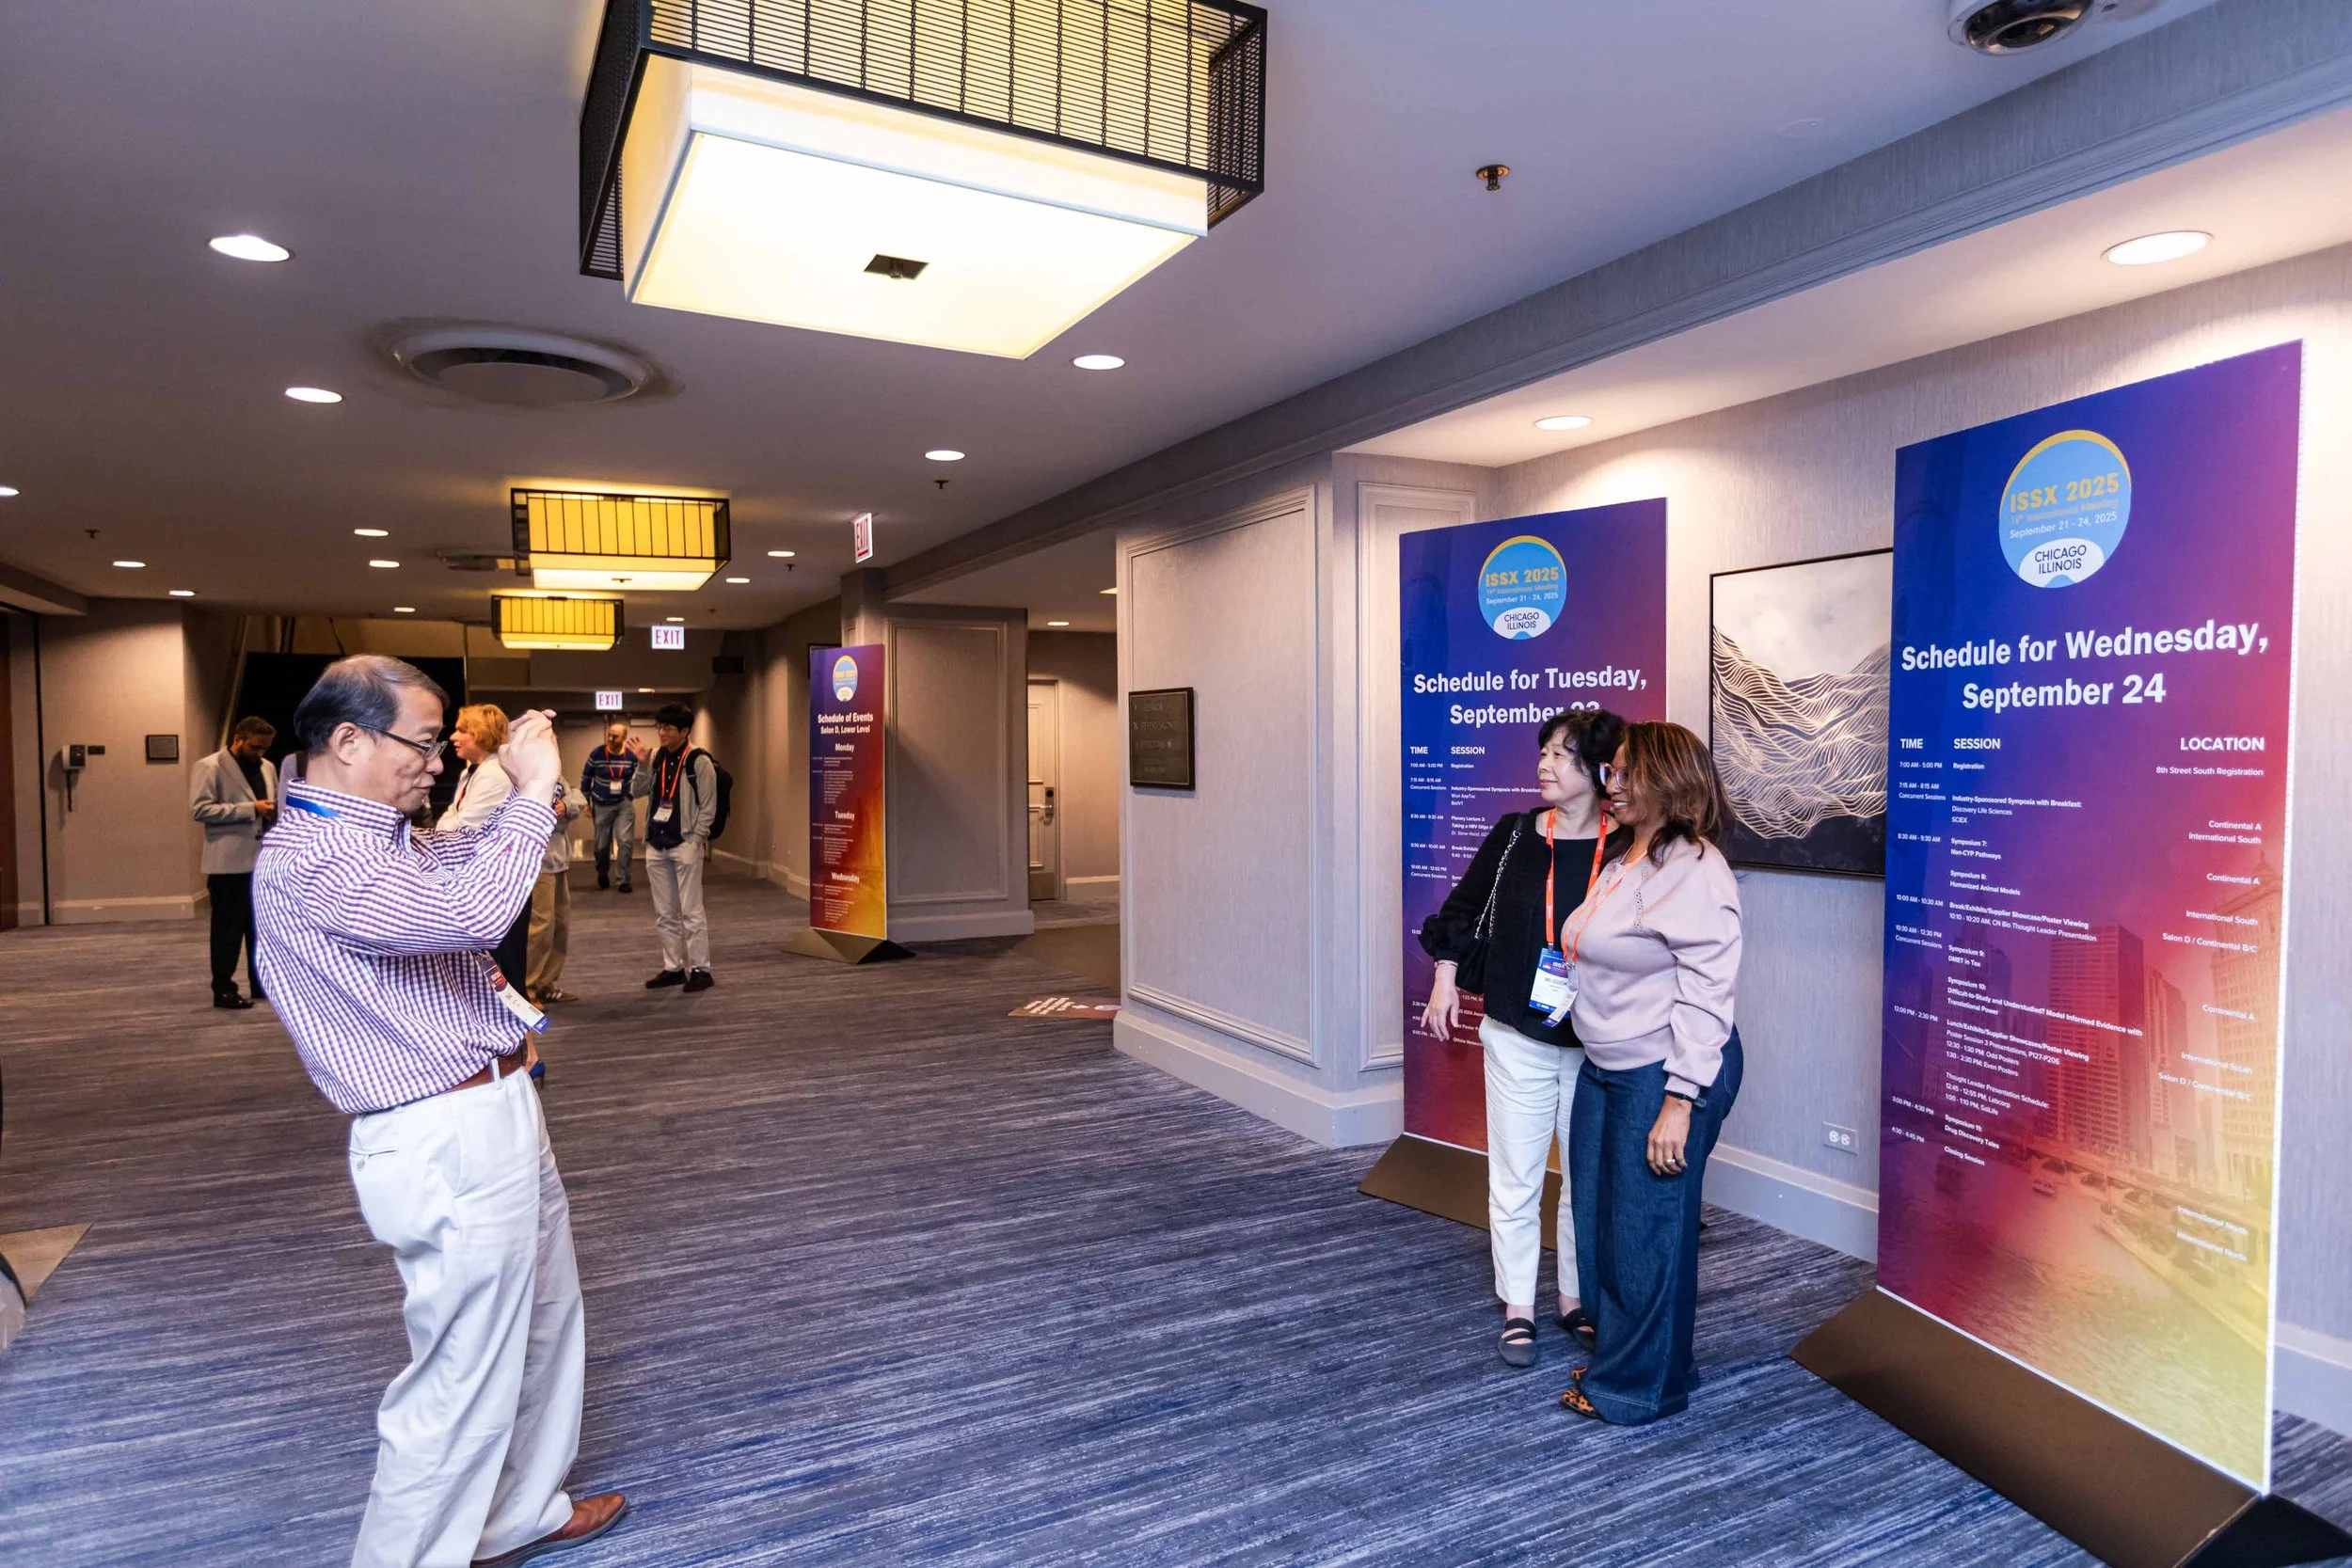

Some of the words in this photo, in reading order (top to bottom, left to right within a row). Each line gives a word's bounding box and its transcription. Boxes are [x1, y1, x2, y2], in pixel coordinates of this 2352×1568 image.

[2010, 485, 2058, 513] ISSX
[2066, 472, 2120, 502] 2025
[2010, 525, 2056, 539] September
[2058, 521, 2068, 531] 21
[2077, 517, 2090, 528] 24,
[2094, 512, 2117, 524] 2025
[2034, 545, 2087, 562] CHICAGO
[2038, 559, 2082, 574] ILLINOIS
[1486, 571, 1518, 587] ISSX
[1524, 566, 1559, 583] 2025
[1486, 596, 1518, 605] September
[1543, 592, 1558, 600] 2025
[1503, 611, 1539, 623] CHICAGO
[1507, 621, 1536, 630] ILLINOIS
[655, 630, 680, 644] EXIT
[1900, 639, 2011, 672] Schedule
[2018, 635, 2057, 663] for
[2065, 620, 2269, 658] Wednesday,
[1413, 671, 1504, 693] Schedule
[1510, 670, 1539, 690] for
[1545, 666, 1646, 690] Tuesday,
[598, 694, 619, 705] EXIT
[1962, 678, 2114, 714] September
[2122, 673, 2167, 705] 24
[818, 713, 844, 723] Schedule
[845, 713, 851, 722] of
[852, 712, 873, 722] Events
[1450, 703, 1564, 728] September
[841, 725, 855, 734] Lower
[856, 724, 870, 734] Level
[835, 743, 854, 752] Monday
[1900, 738, 1922, 749] TIME
[1954, 738, 2000, 749] SESSION
[2180, 737, 2264, 751] LOCATION
[835, 811, 855, 821] Tuesday
[1952, 805, 1977, 814] Discovery
[2209, 820, 2252, 830] Continental
[2189, 833, 2235, 842] International
[1975, 851, 2001, 860] Pathways
[832, 872, 860, 884] Wednesday
[1950, 870, 1979, 879] Symposium
[2207, 874, 2250, 884] Continental
[1950, 881, 1979, 890] Humanized
[1999, 887, 2020, 895] Models
[2062, 919, 2089, 929] Viewing
[2186, 911, 2233, 923] International
[2234, 916, 2257, 926] South
[2011, 923, 2035, 932] Thought
[2036, 927, 2057, 935] Leader
[2058, 929, 2096, 941] Presentation
[1896, 935, 1920, 944] Concurrent
[1920, 940, 1942, 948] Sessions
[2163, 933, 2183, 942] Salon
[2196, 938, 2240, 950] Continental
[1948, 944, 1979, 955] Symposium
[1947, 976, 1978, 988] Symposium
[1947, 998, 1980, 1010] Translational
[1980, 1006, 1998, 1014] Power
[2202, 1005, 2247, 1019] Continental
[2045, 1009, 2065, 1019] Model
[2065, 1014, 2094, 1025] Informed
[2095, 1021, 2126, 1033] Evidence
[2126, 1028, 2142, 1037] with
[1947, 1030, 1963, 1038] Poster
[1963, 1035, 1983, 1044] Session
[1988, 1041, 2026, 1056] Presentations,
[1998, 1054, 2019, 1065] Posters
[2063, 1049, 2089, 1061] Viewing
[1983, 1061, 1996, 1069] Even
[1997, 1066, 2018, 1076] Posters
[1947, 1072, 1966, 1083] Thought
[1966, 1079, 1985, 1088] Leader
[1985, 1085, 2020, 1099] Presentation
[1946, 1115, 1975, 1129] Symposium
[1945, 1125, 1957, 1134] Drug
[1957, 1130, 1983, 1144] Discovery
[1945, 1147, 1963, 1159] Closing
[1963, 1153, 1984, 1165] Session
